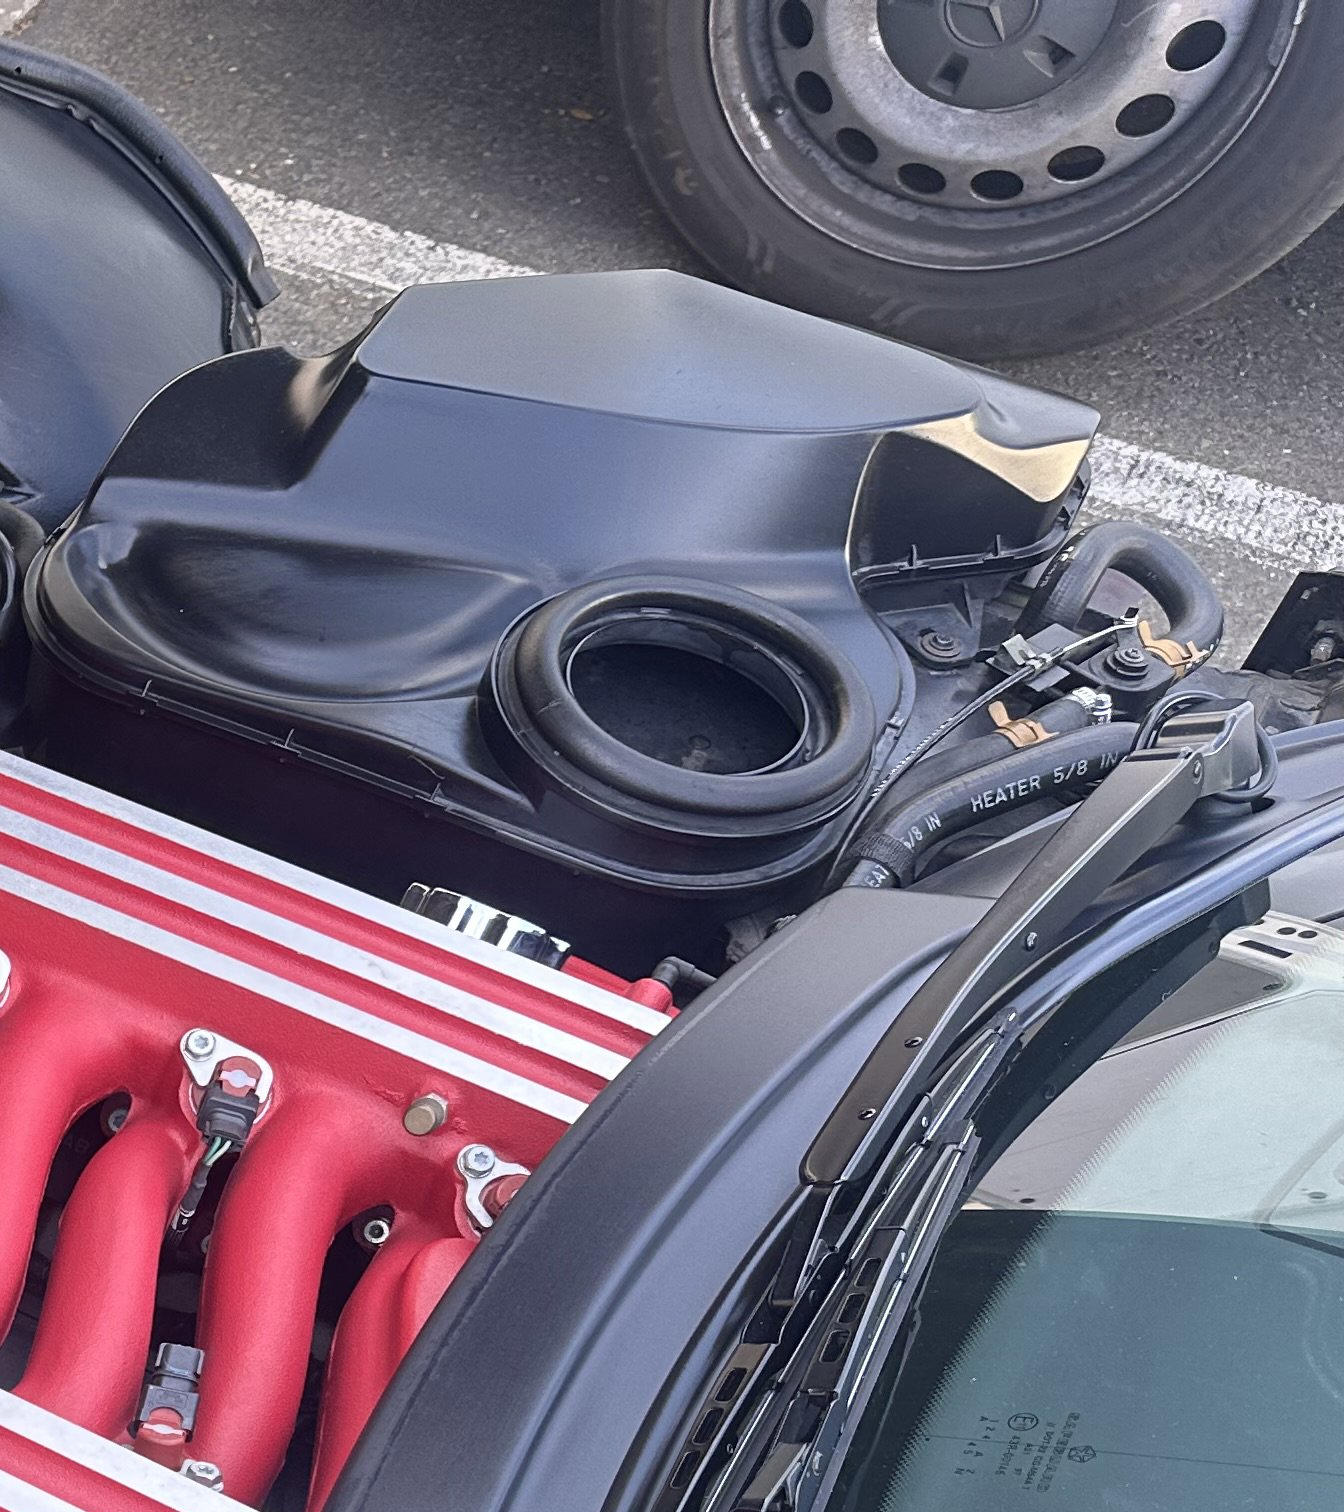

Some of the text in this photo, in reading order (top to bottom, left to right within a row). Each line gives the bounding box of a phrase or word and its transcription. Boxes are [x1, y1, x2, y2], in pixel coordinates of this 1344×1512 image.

[971, 775, 1041, 813] HEATER
[1054, 759, 1088, 784] 5/8
[924, 812, 942, 831] IN
